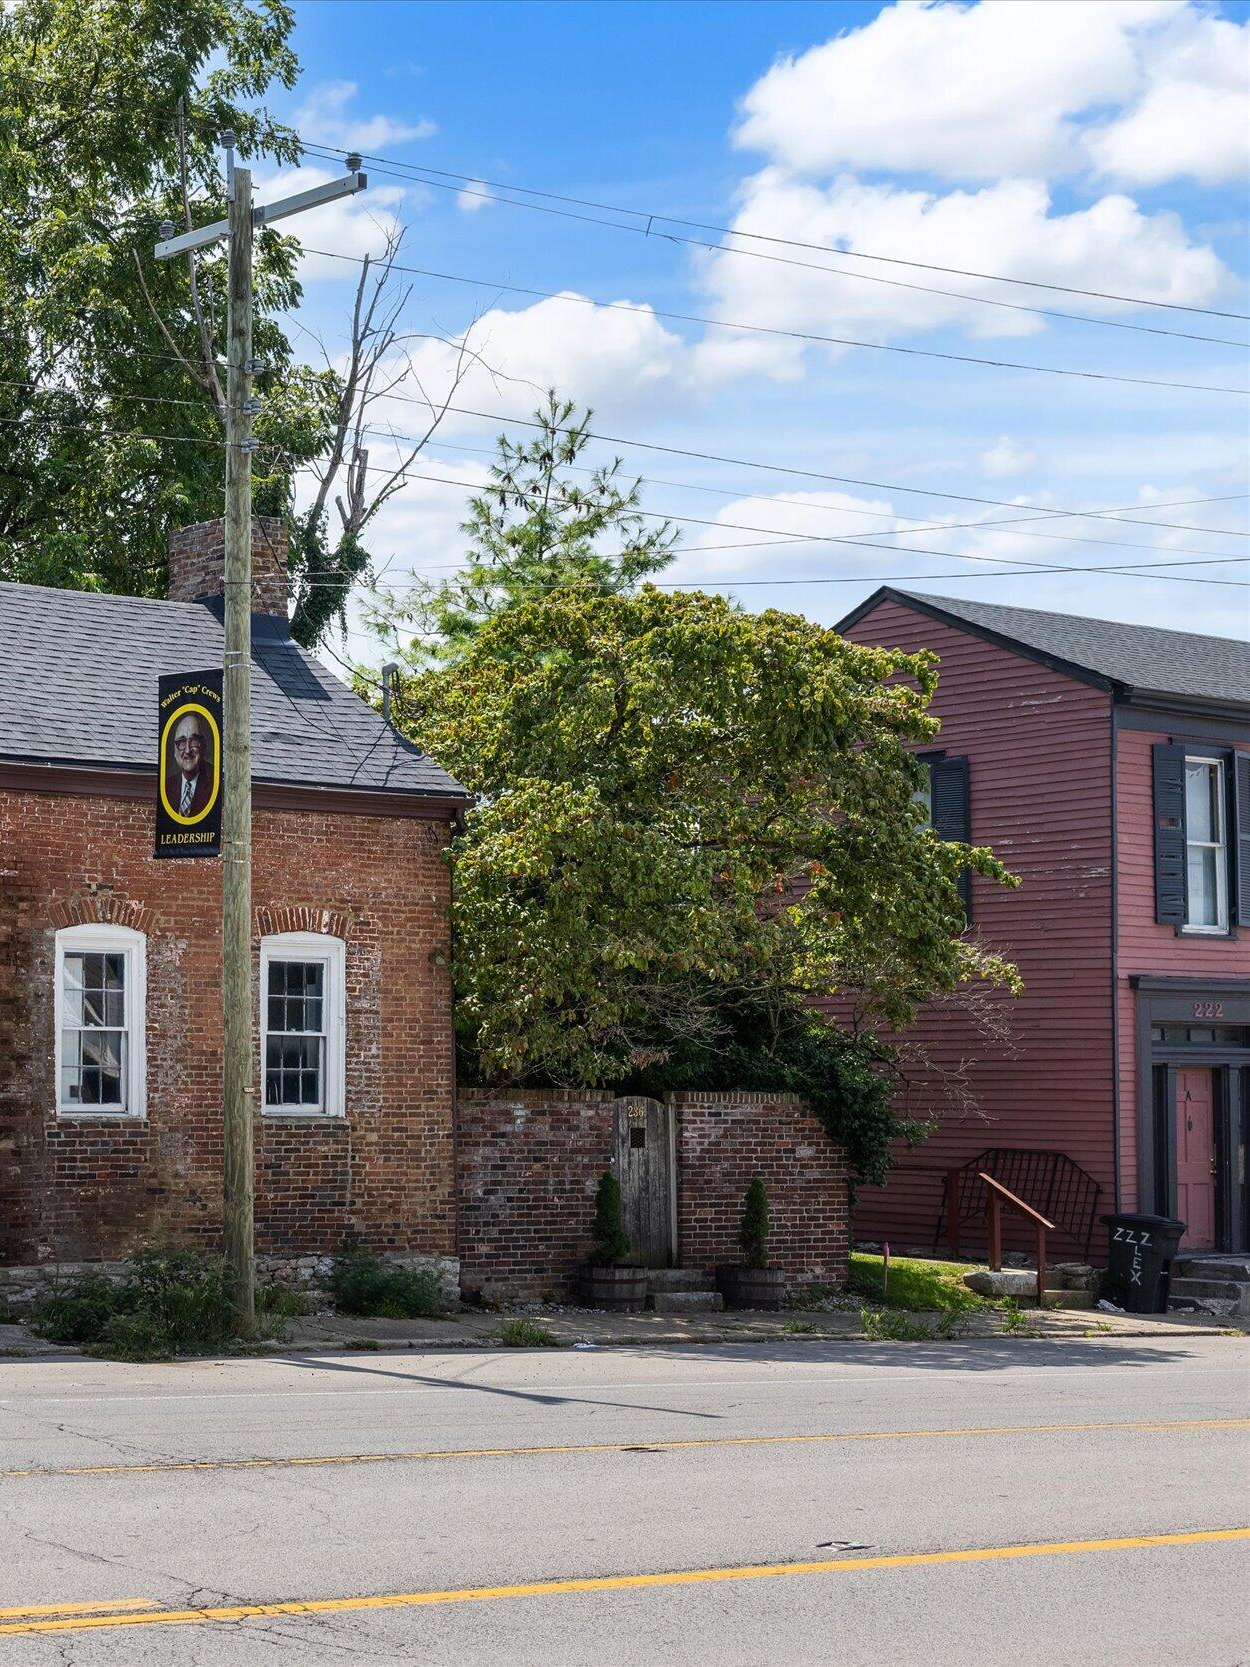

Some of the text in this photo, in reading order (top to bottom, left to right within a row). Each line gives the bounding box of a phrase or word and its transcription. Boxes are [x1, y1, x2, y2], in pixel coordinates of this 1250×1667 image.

[160, 684, 221, 708] Walter "Cap" Crews
[161, 832, 215, 845] LEADERSHIP
[1194, 1002, 1224, 1018] 222
[1185, 1090, 1192, 1101] A
[1130, 1245, 1142, 1286] LEX
